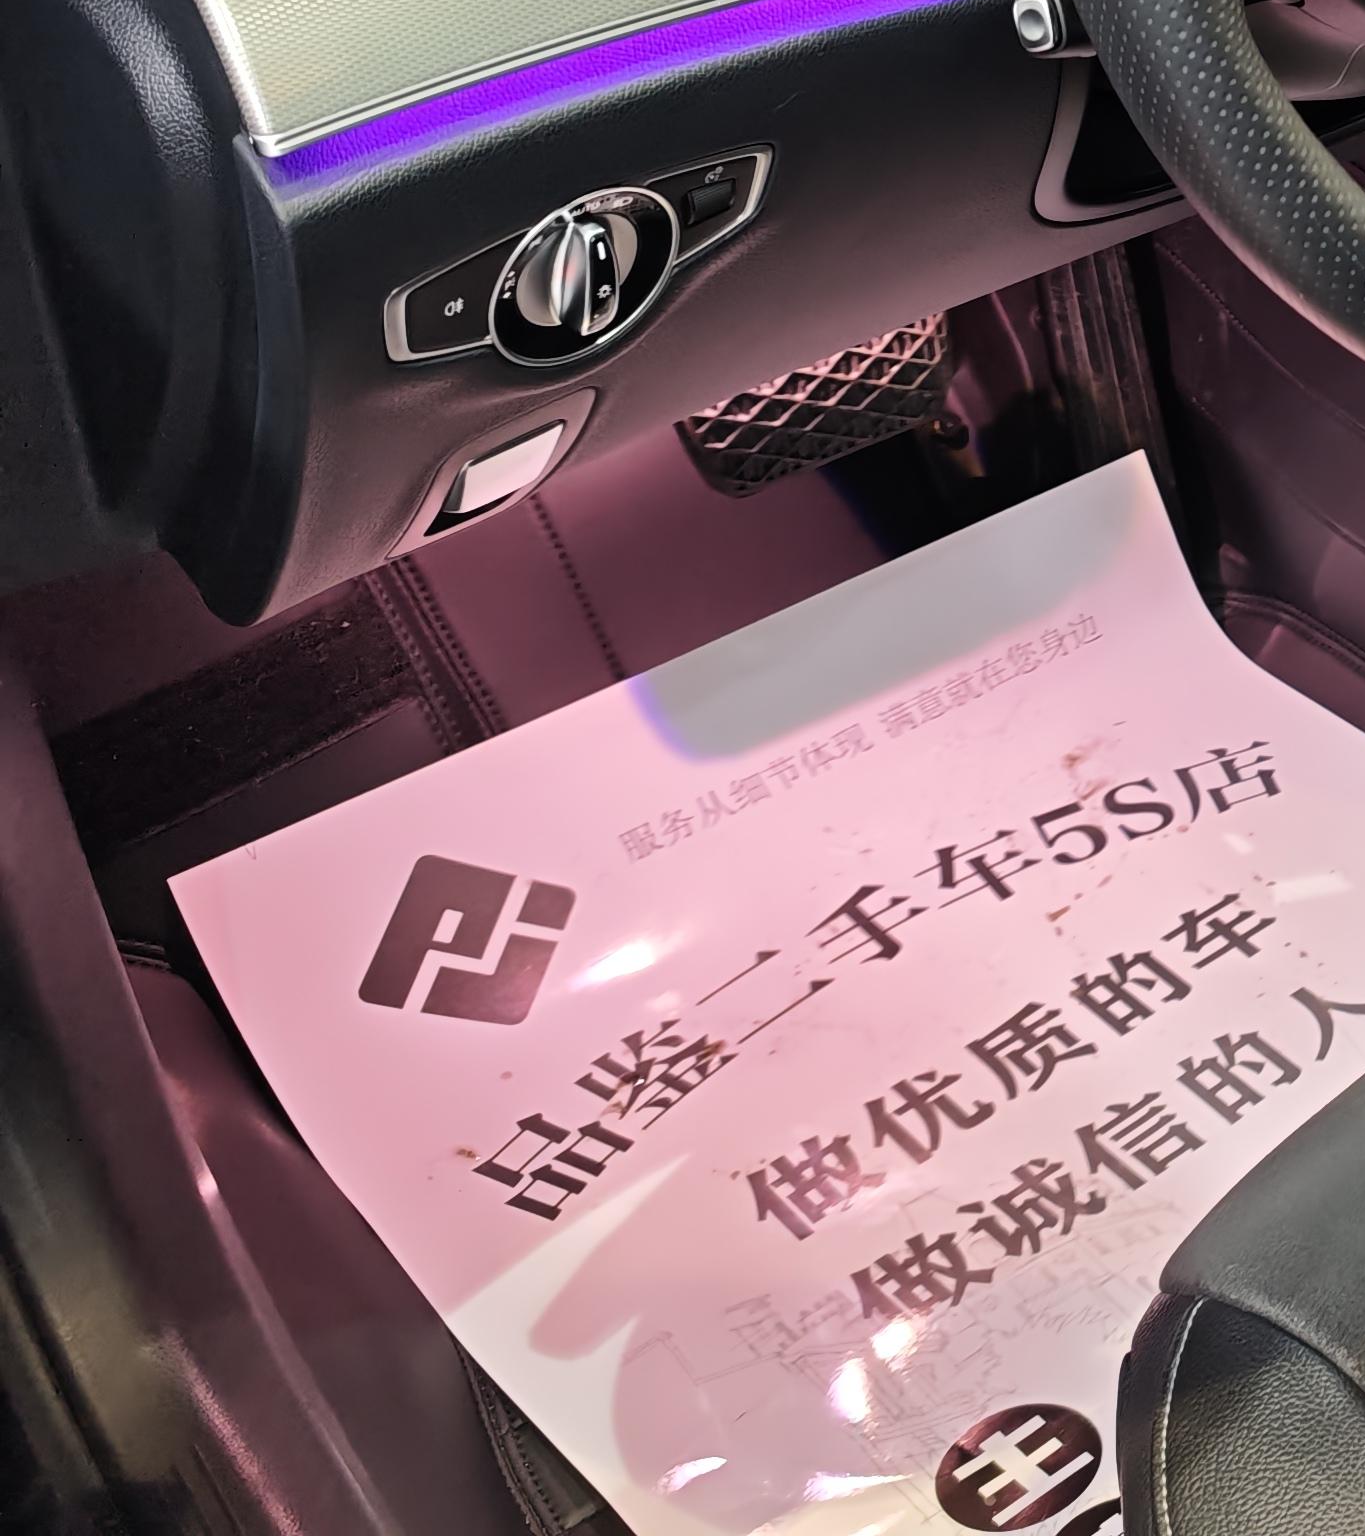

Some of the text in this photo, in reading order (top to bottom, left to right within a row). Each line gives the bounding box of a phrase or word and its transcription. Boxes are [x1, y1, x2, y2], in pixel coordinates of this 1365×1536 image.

[616, 612, 1104, 864] 服务从细节体现 满意就在您身边
[471, 736, 1287, 1221] 品鉴二手车5S店
[745, 891, 1277, 1241] 做优质的车
